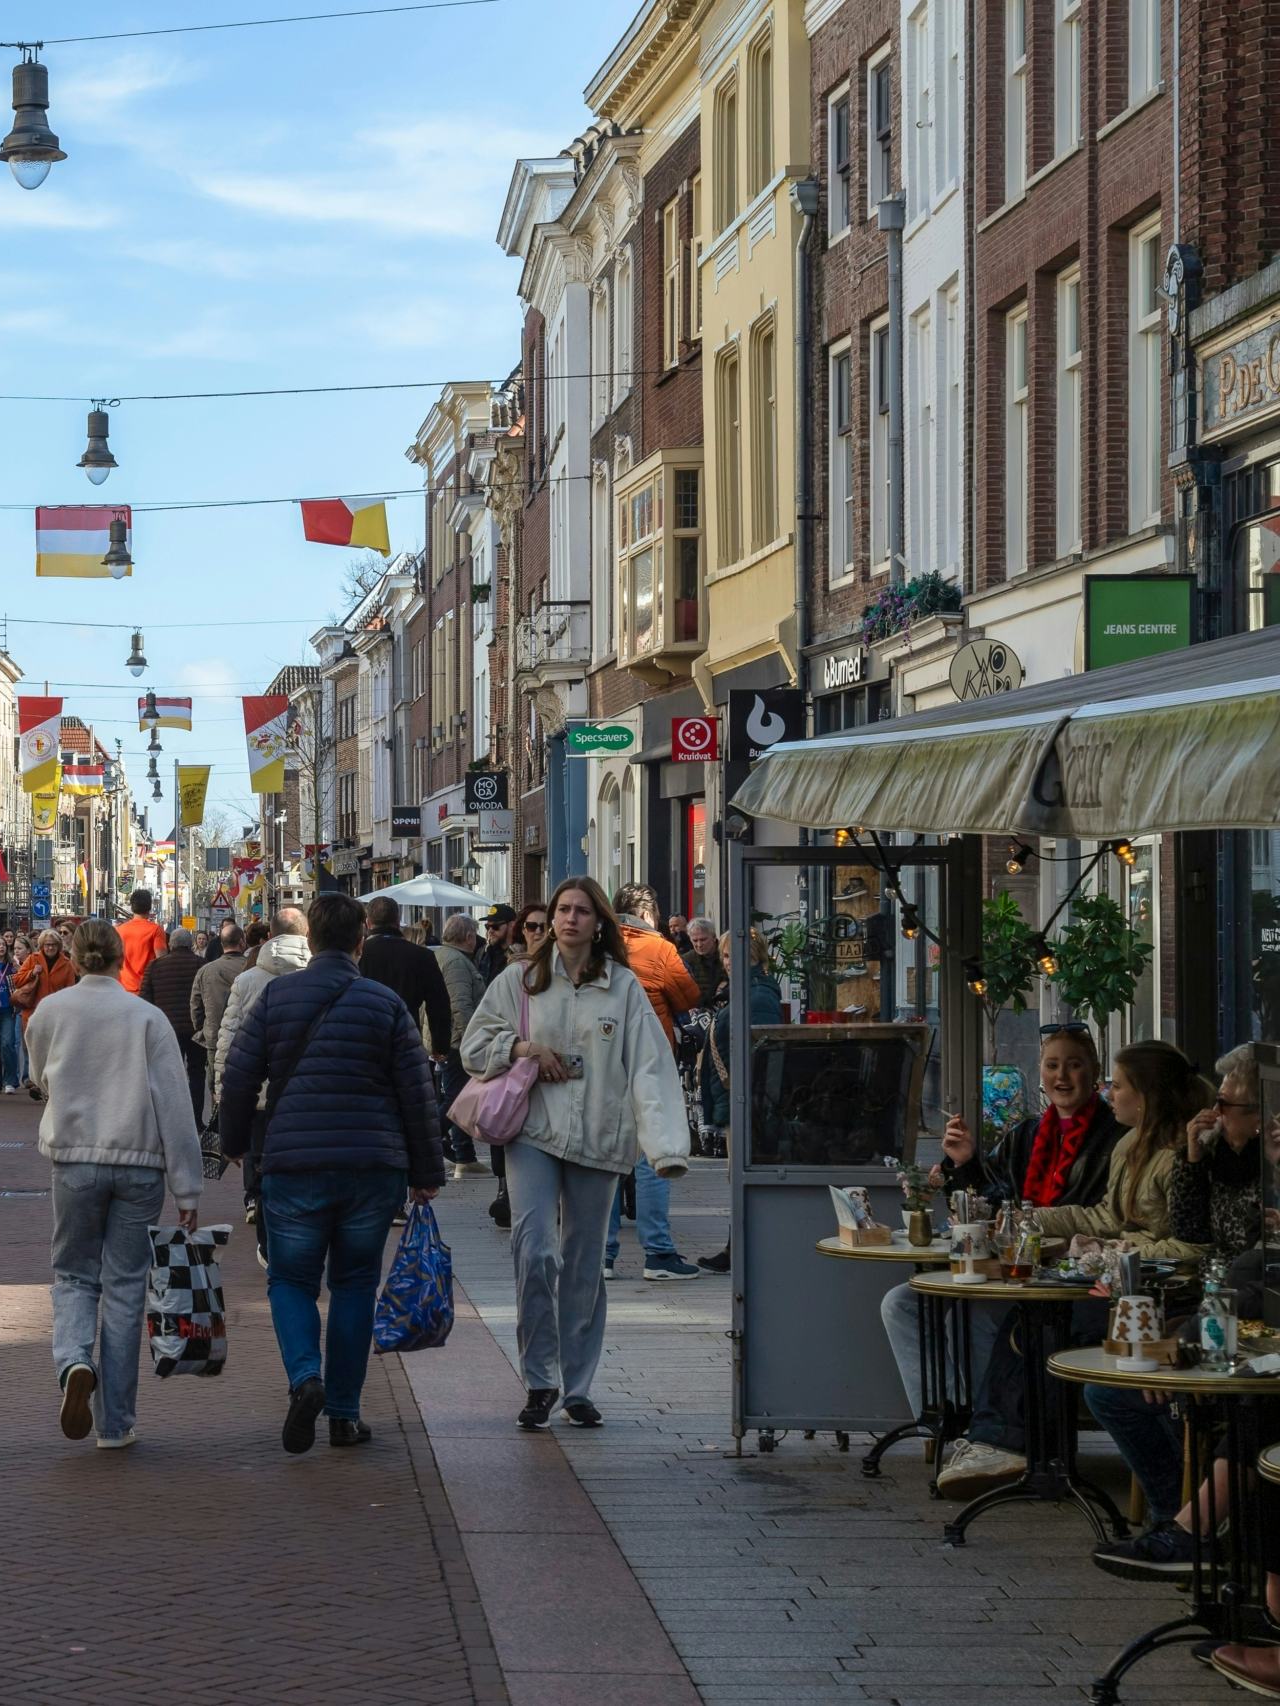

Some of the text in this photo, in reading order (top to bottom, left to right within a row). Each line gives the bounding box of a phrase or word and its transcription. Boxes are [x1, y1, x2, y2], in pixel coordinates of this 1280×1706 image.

[1103, 623, 1177, 635] JEANS CENTRE
[829, 647, 861, 688] Burned
[575, 732, 629, 744] Specsavers
[678, 751, 712, 760] Kruidvat
[469, 801, 503, 810] OMODA
